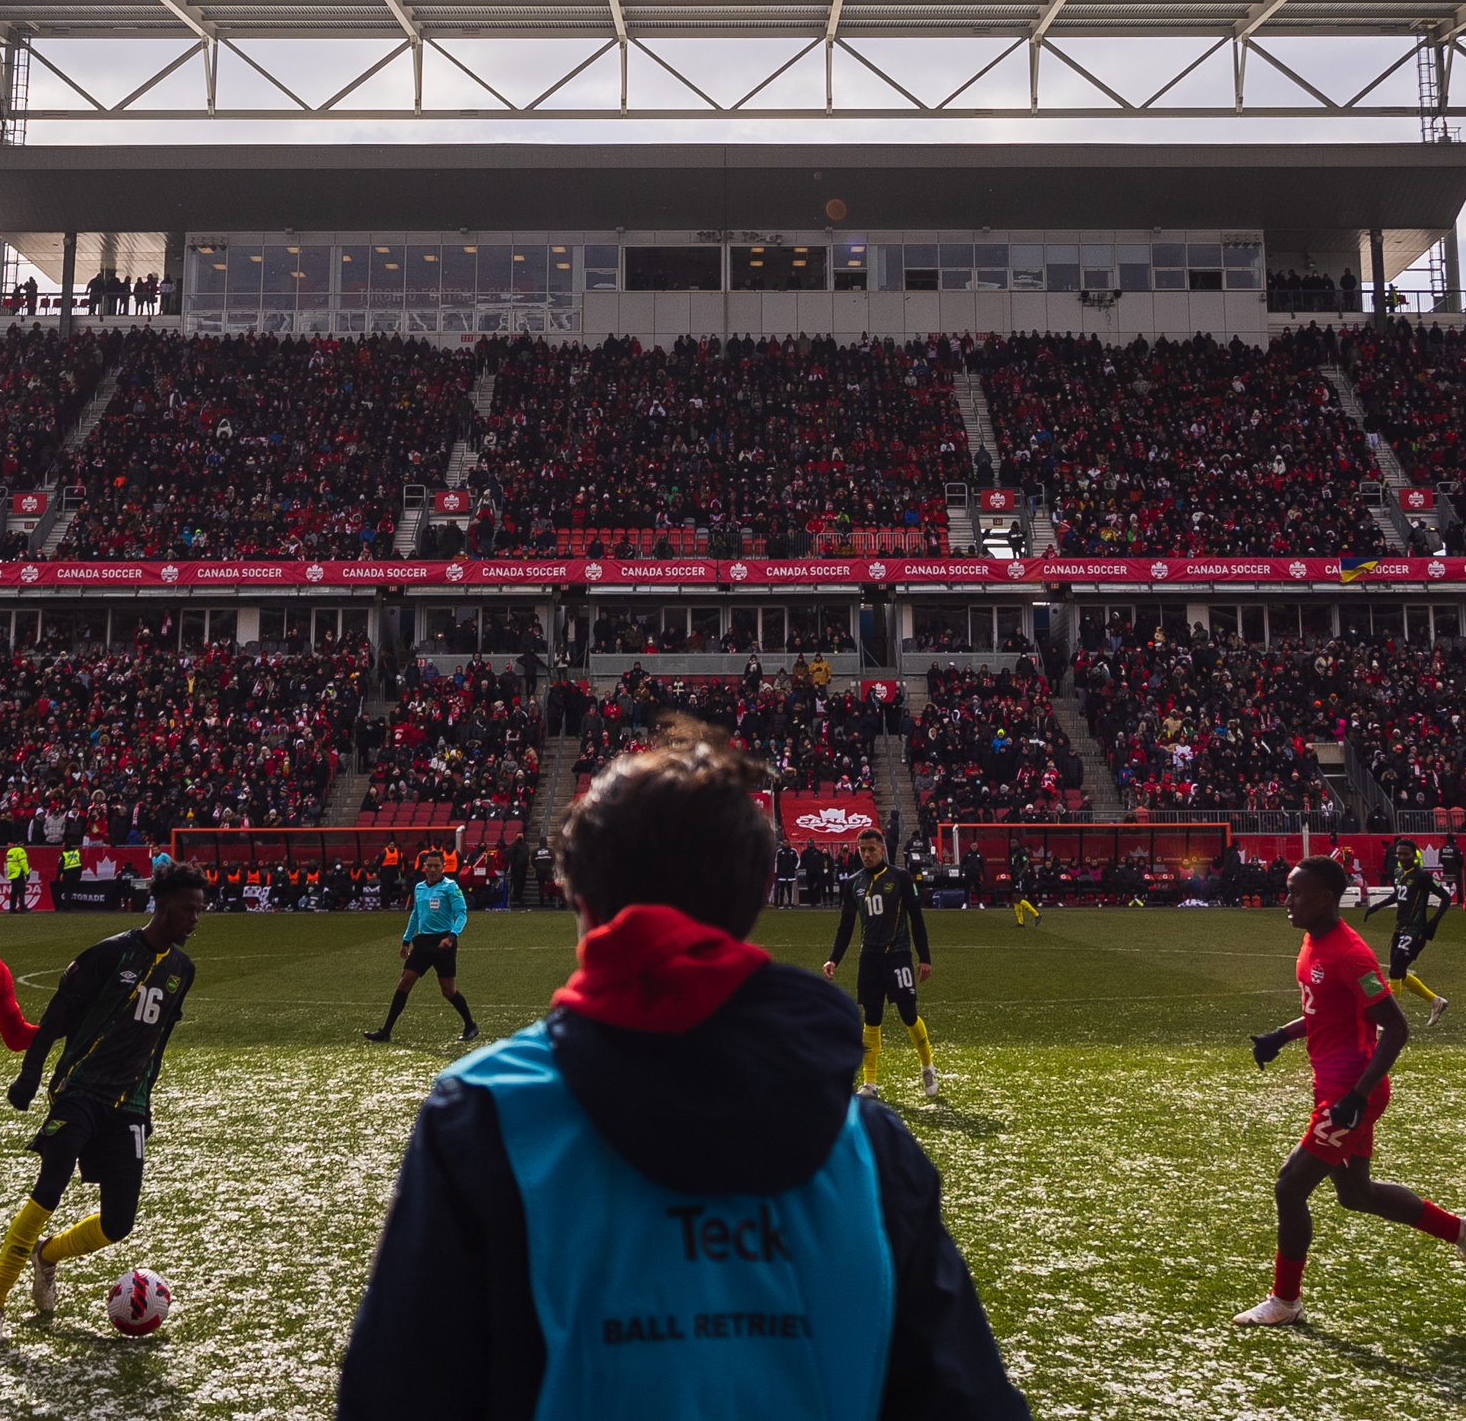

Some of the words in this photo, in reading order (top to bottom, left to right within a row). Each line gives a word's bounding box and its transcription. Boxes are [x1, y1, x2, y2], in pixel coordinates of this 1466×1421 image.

[57, 568, 99, 579] CANADA
[102, 568, 142, 579] SOCCER
[197, 568, 239, 578] CANADA
[242, 568, 282, 578] SOCCER
[342, 568, 384, 578] CANADA
[387, 568, 427, 578] SOCCER
[482, 567, 524, 577] CANADA
[527, 567, 567, 577] SOCCER
[621, 566, 663, 577] CANADA
[666, 566, 705, 577] SOCCER
[766, 566, 808, 577] CANADA
[811, 566, 850, 577] SOCCER
[904, 565, 946, 576] CANADA
[949, 565, 989, 576] SOCCER
[1043, 565, 1085, 576] CANADA
[1088, 565, 1127, 576] SOCCER
[1187, 564, 1228, 575] CANADA
[1231, 564, 1270, 575] SOCCER
[865, 894, 884, 916] 10
[1398, 935, 1412, 951] 22
[134, 985, 164, 1024] 16
[129, 1123, 146, 1159] 1
[666, 1204, 790, 1262] Teck
[603, 1317, 684, 1345] BALL
